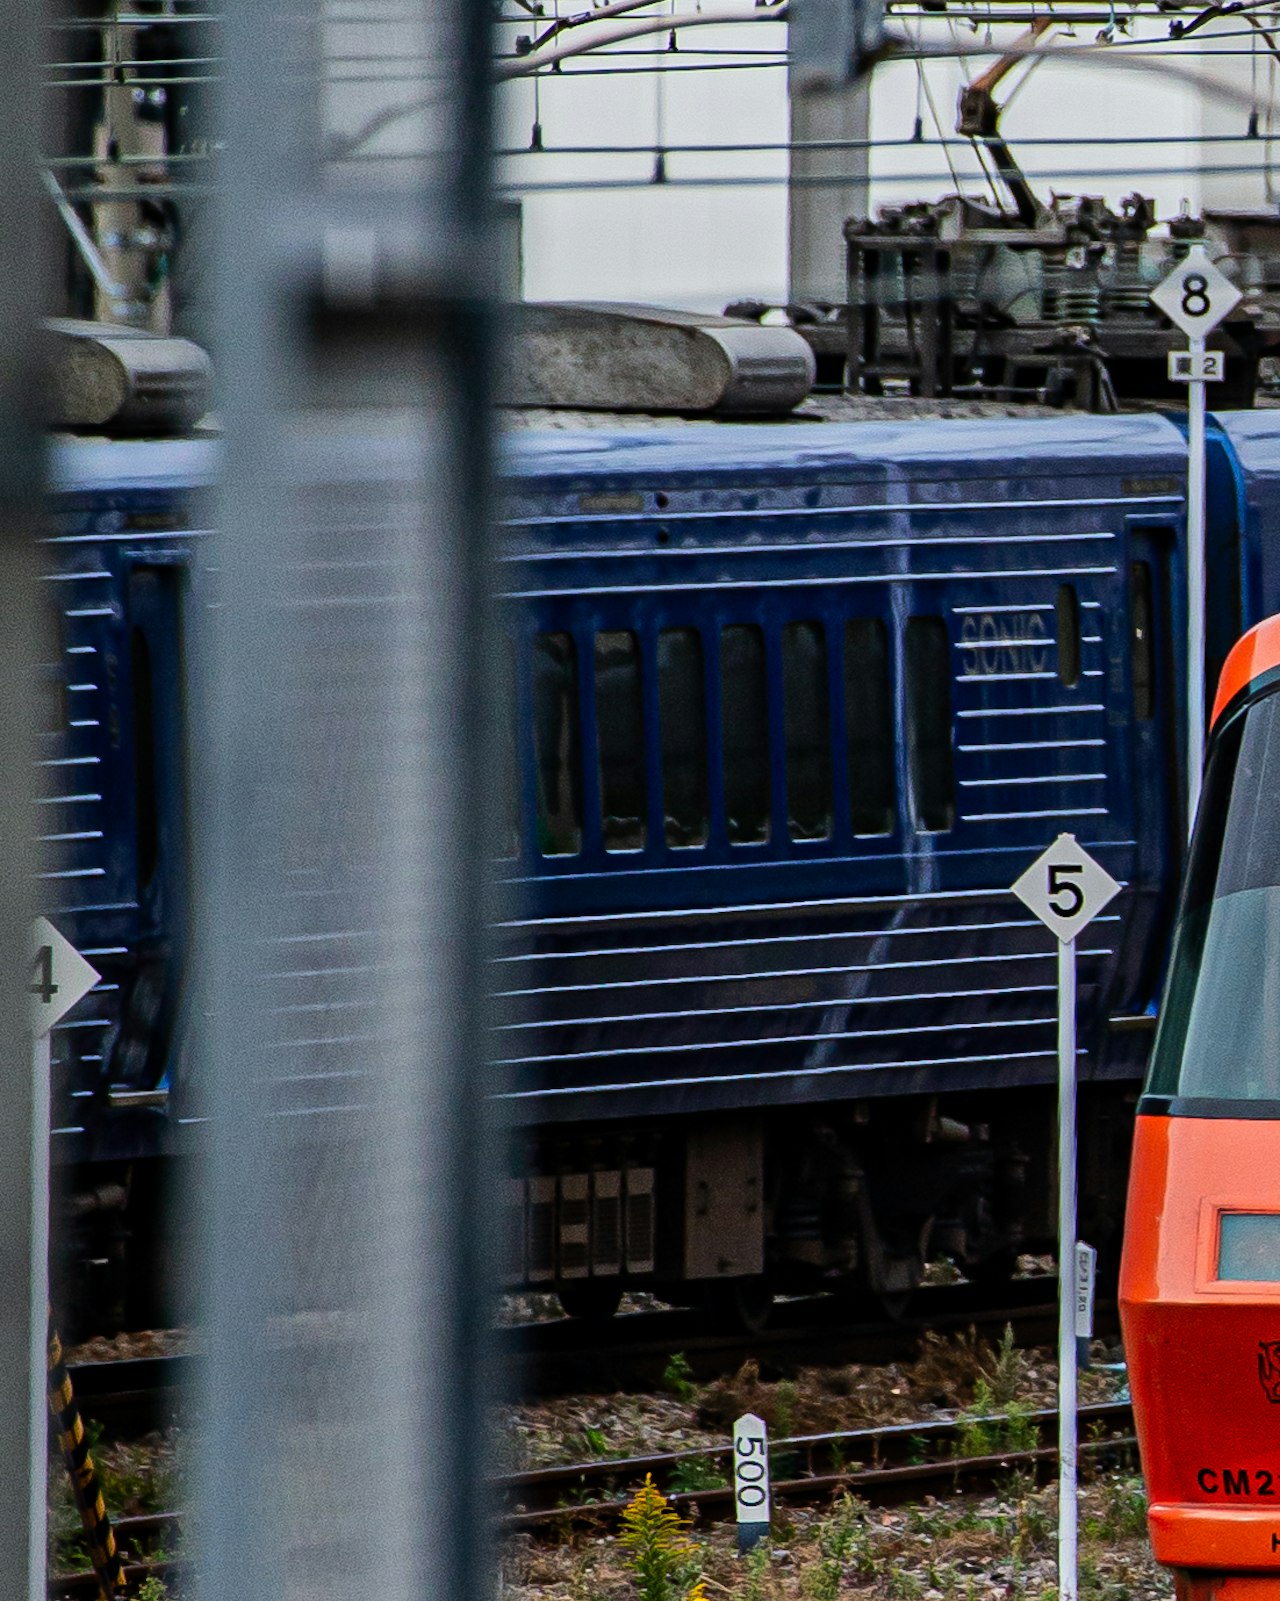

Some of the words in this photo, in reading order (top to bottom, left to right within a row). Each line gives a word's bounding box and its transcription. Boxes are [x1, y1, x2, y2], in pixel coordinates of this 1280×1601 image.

[1182, 273, 1210, 317] 8
[1048, 864, 1084, 918] 5
[736, 1436, 765, 1507] 500
